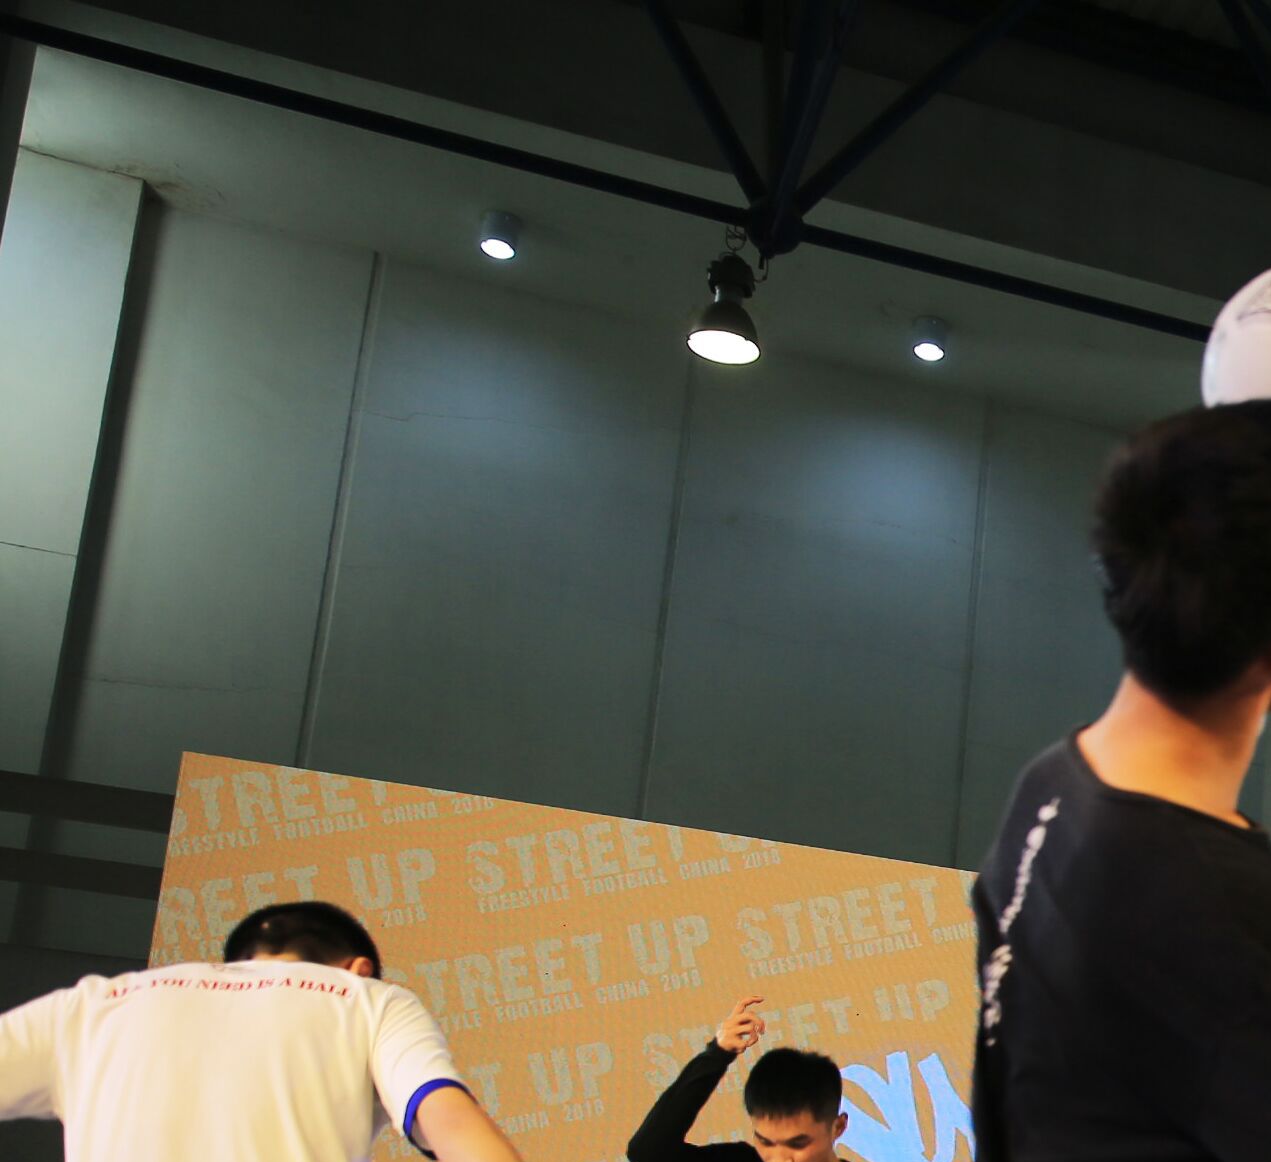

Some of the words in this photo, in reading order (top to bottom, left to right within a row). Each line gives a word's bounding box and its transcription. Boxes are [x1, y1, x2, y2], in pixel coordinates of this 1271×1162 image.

[346, 847, 437, 911] UP
[477, 882, 572, 914] FREESTYLE
[583, 870, 671, 897] FOOTBALL
[680, 856, 732, 879] CHINA
[627, 915, 710, 976] UP
[735, 876, 938, 960] STREET
[149, 978, 194, 990] YOU
[197, 979, 252, 991] NEED
[278, 976, 293, 988] A
[748, 947, 834, 978] FREESTYLE
[844, 930, 924, 960] FOOTBALL
[497, 990, 584, 1024] FOOTBALL
[595, 978, 650, 1006] CHINA
[527, 1041, 615, 1106] UP
